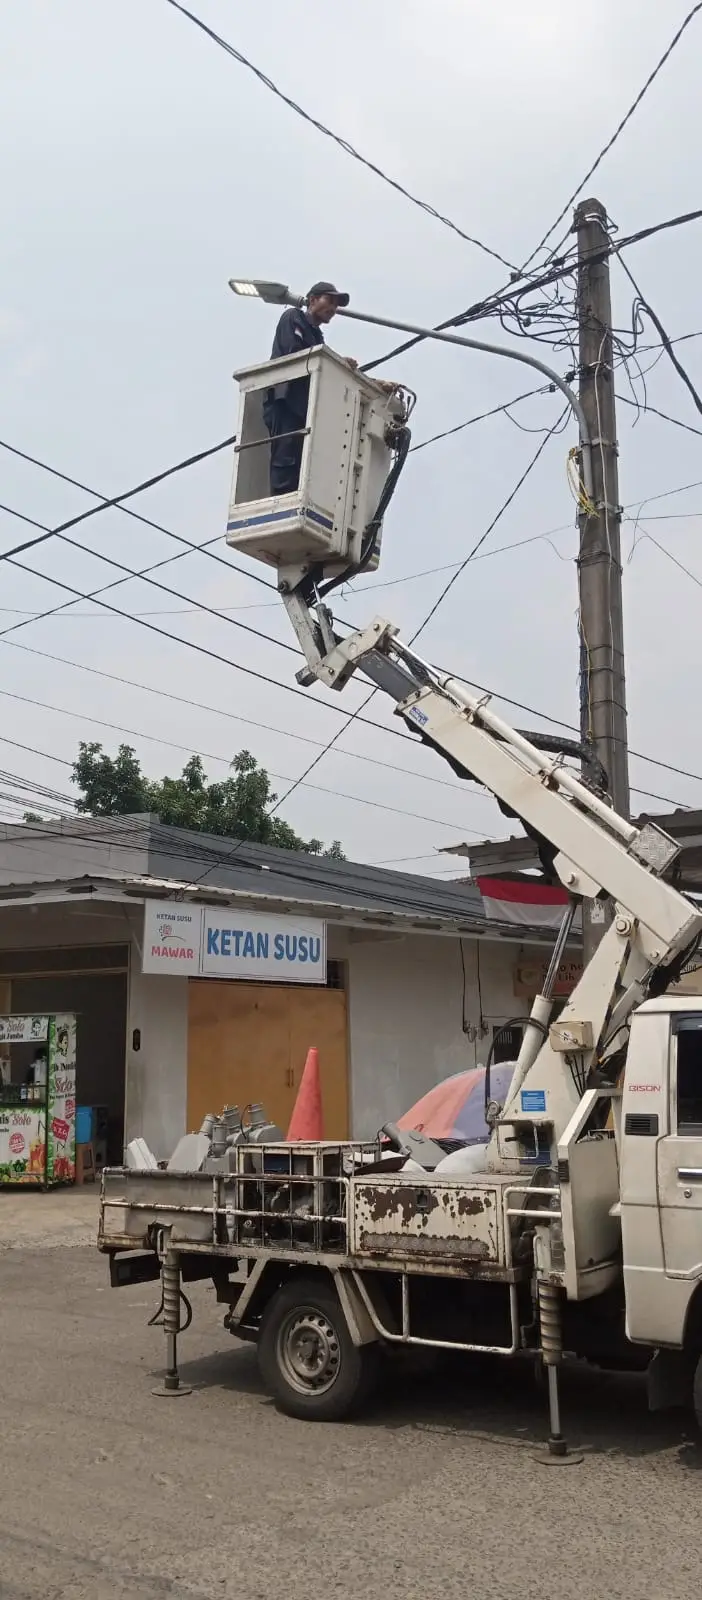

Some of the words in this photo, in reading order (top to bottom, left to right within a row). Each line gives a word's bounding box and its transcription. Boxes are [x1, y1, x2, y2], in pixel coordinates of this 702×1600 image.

[156, 913, 175, 921] KETAN
[151, 945, 194, 959] MAWAR
[207, 928, 269, 959] KETAN
[274, 934, 321, 963] SUSU
